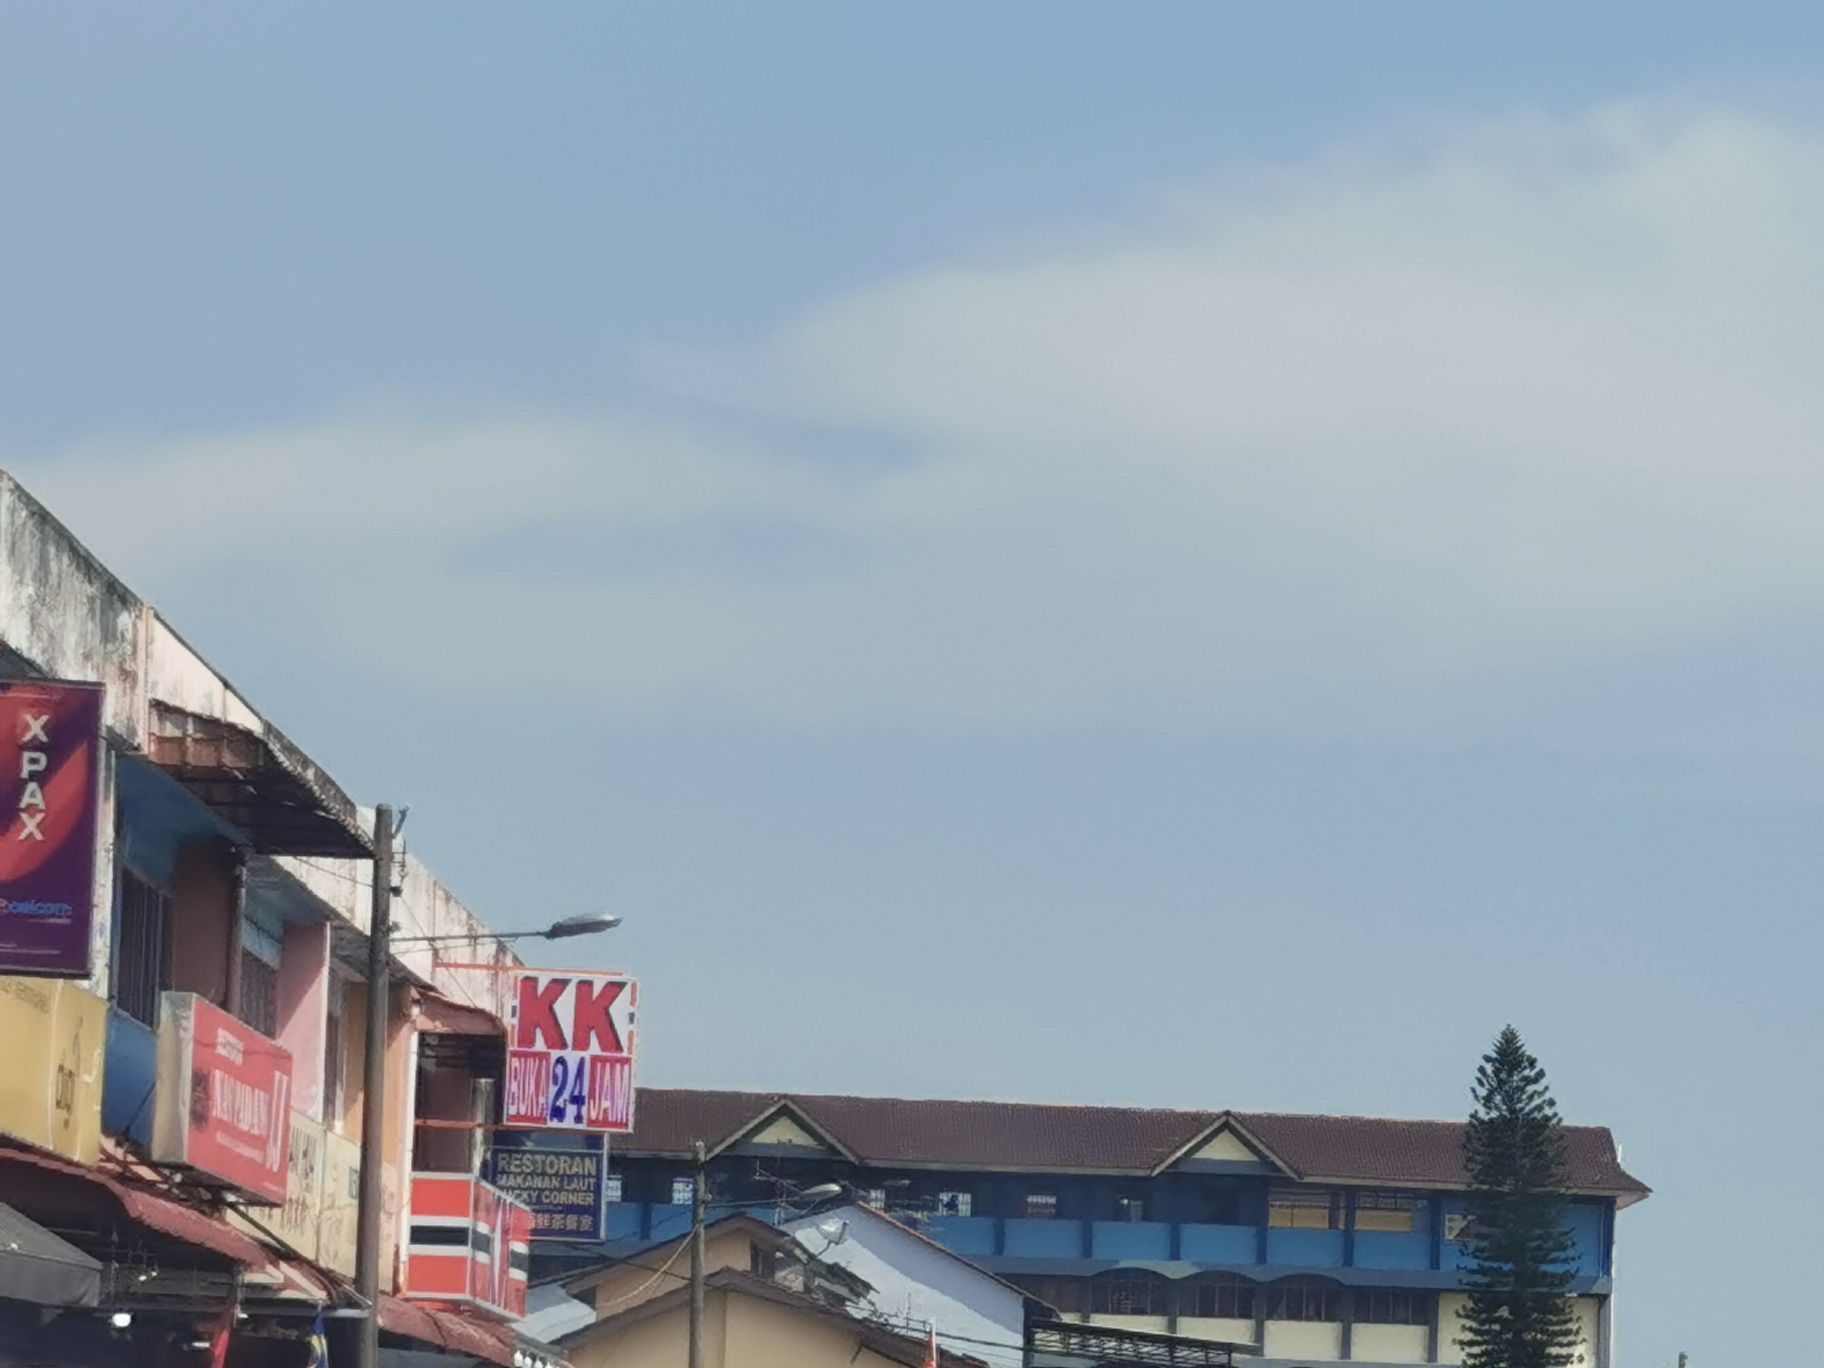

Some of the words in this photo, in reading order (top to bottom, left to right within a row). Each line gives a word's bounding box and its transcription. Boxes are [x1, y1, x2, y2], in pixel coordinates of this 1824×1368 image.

[18, 714, 50, 841] XPAX
[516, 975, 629, 1053] KK
[508, 1056, 549, 1118] BUKA
[550, 1055, 587, 1125] 24
[590, 1061, 629, 1123] JAM
[497, 1152, 597, 1175] RESTORAN
[497, 1172, 560, 1189] MAKANAN
[562, 1175, 597, 1192] LAUT
[541, 1190, 595, 1206] CORNER
